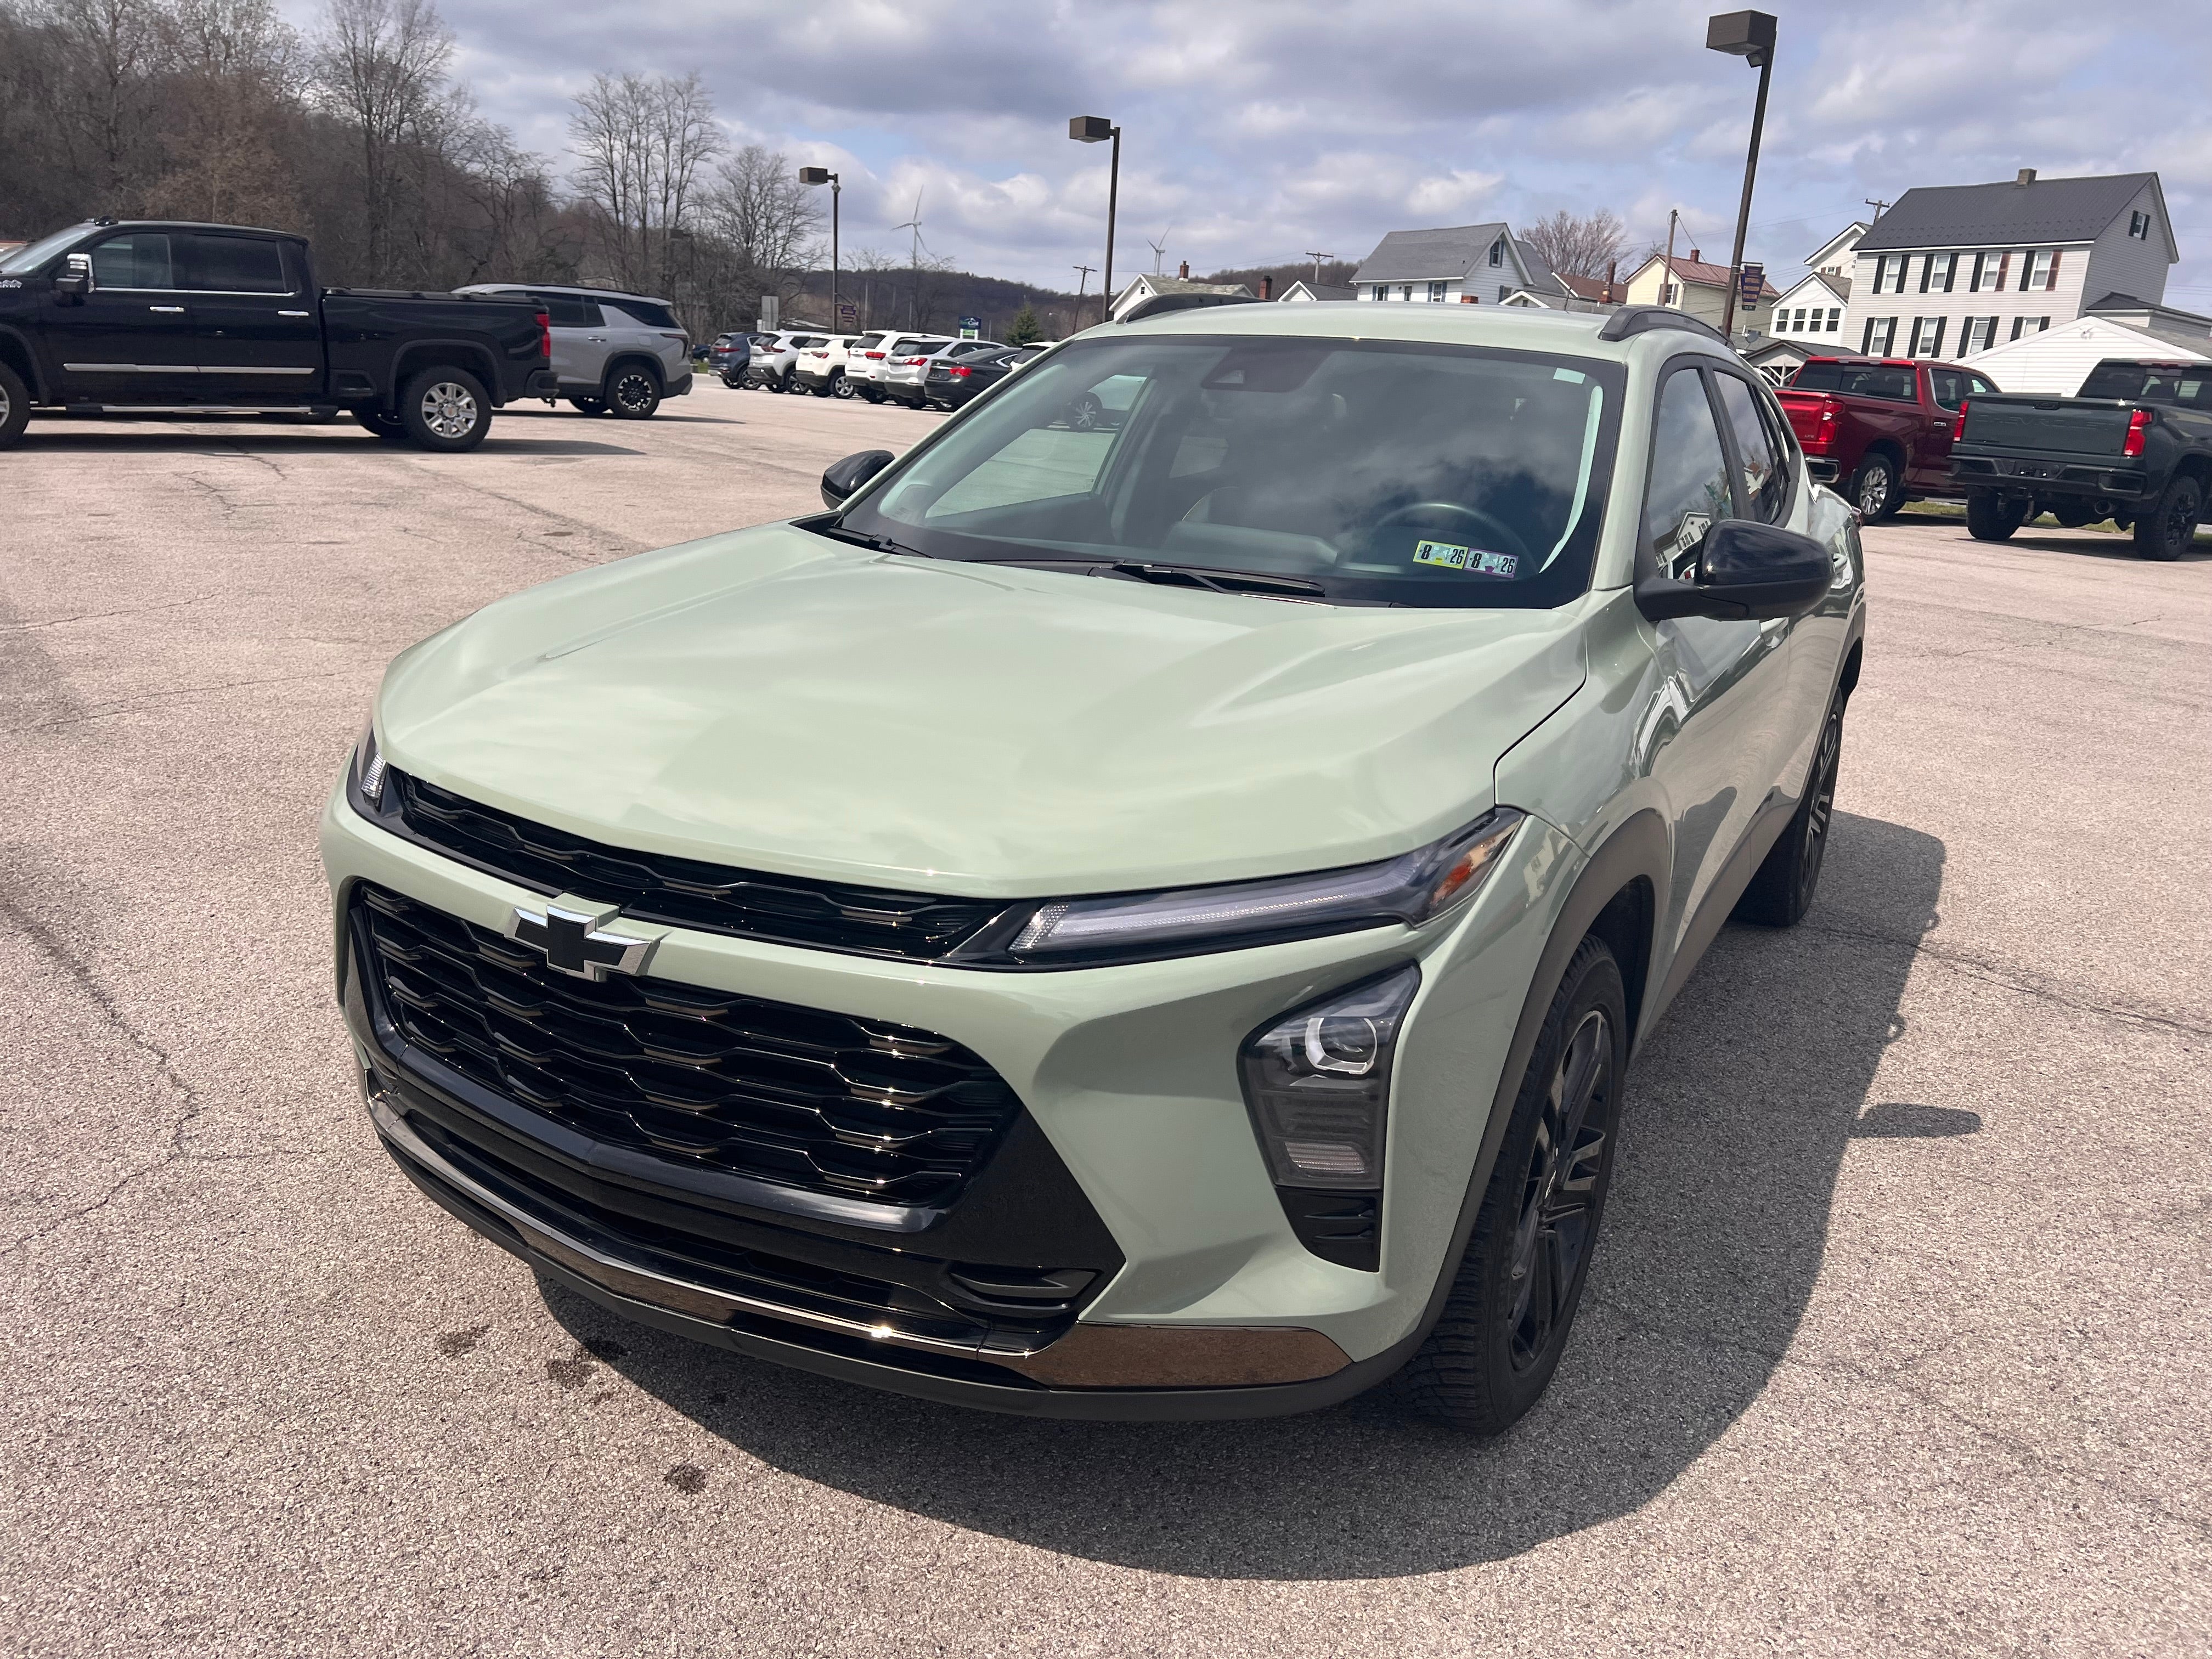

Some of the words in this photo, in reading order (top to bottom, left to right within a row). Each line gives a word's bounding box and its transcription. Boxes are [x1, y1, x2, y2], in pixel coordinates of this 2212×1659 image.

[1421, 544, 1432, 560] 8
[1449, 549, 1465, 565] 26
[1471, 552, 1482, 568] 8
[1500, 557, 1515, 573] 26
